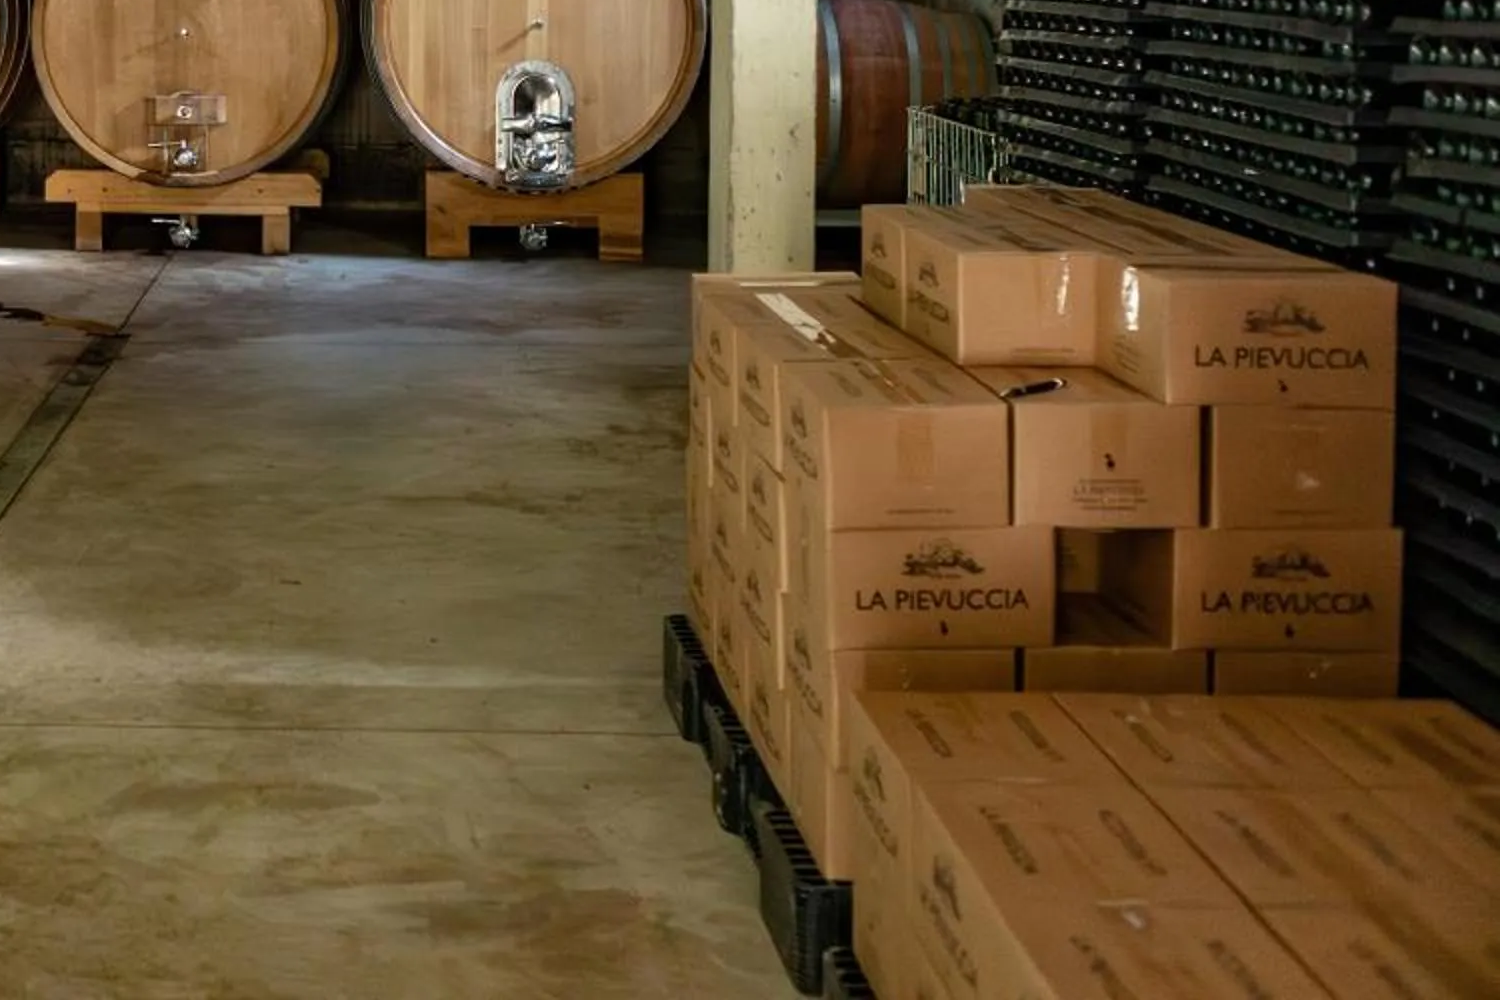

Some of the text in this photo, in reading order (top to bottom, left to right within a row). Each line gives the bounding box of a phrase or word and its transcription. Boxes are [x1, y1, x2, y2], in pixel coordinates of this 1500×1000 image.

[1194, 346, 1369, 370] LA PIEVUCCIA
[856, 588, 1030, 611] LA PIEVUCCIA
[1201, 591, 1375, 615] LA PIEVUCCIA
